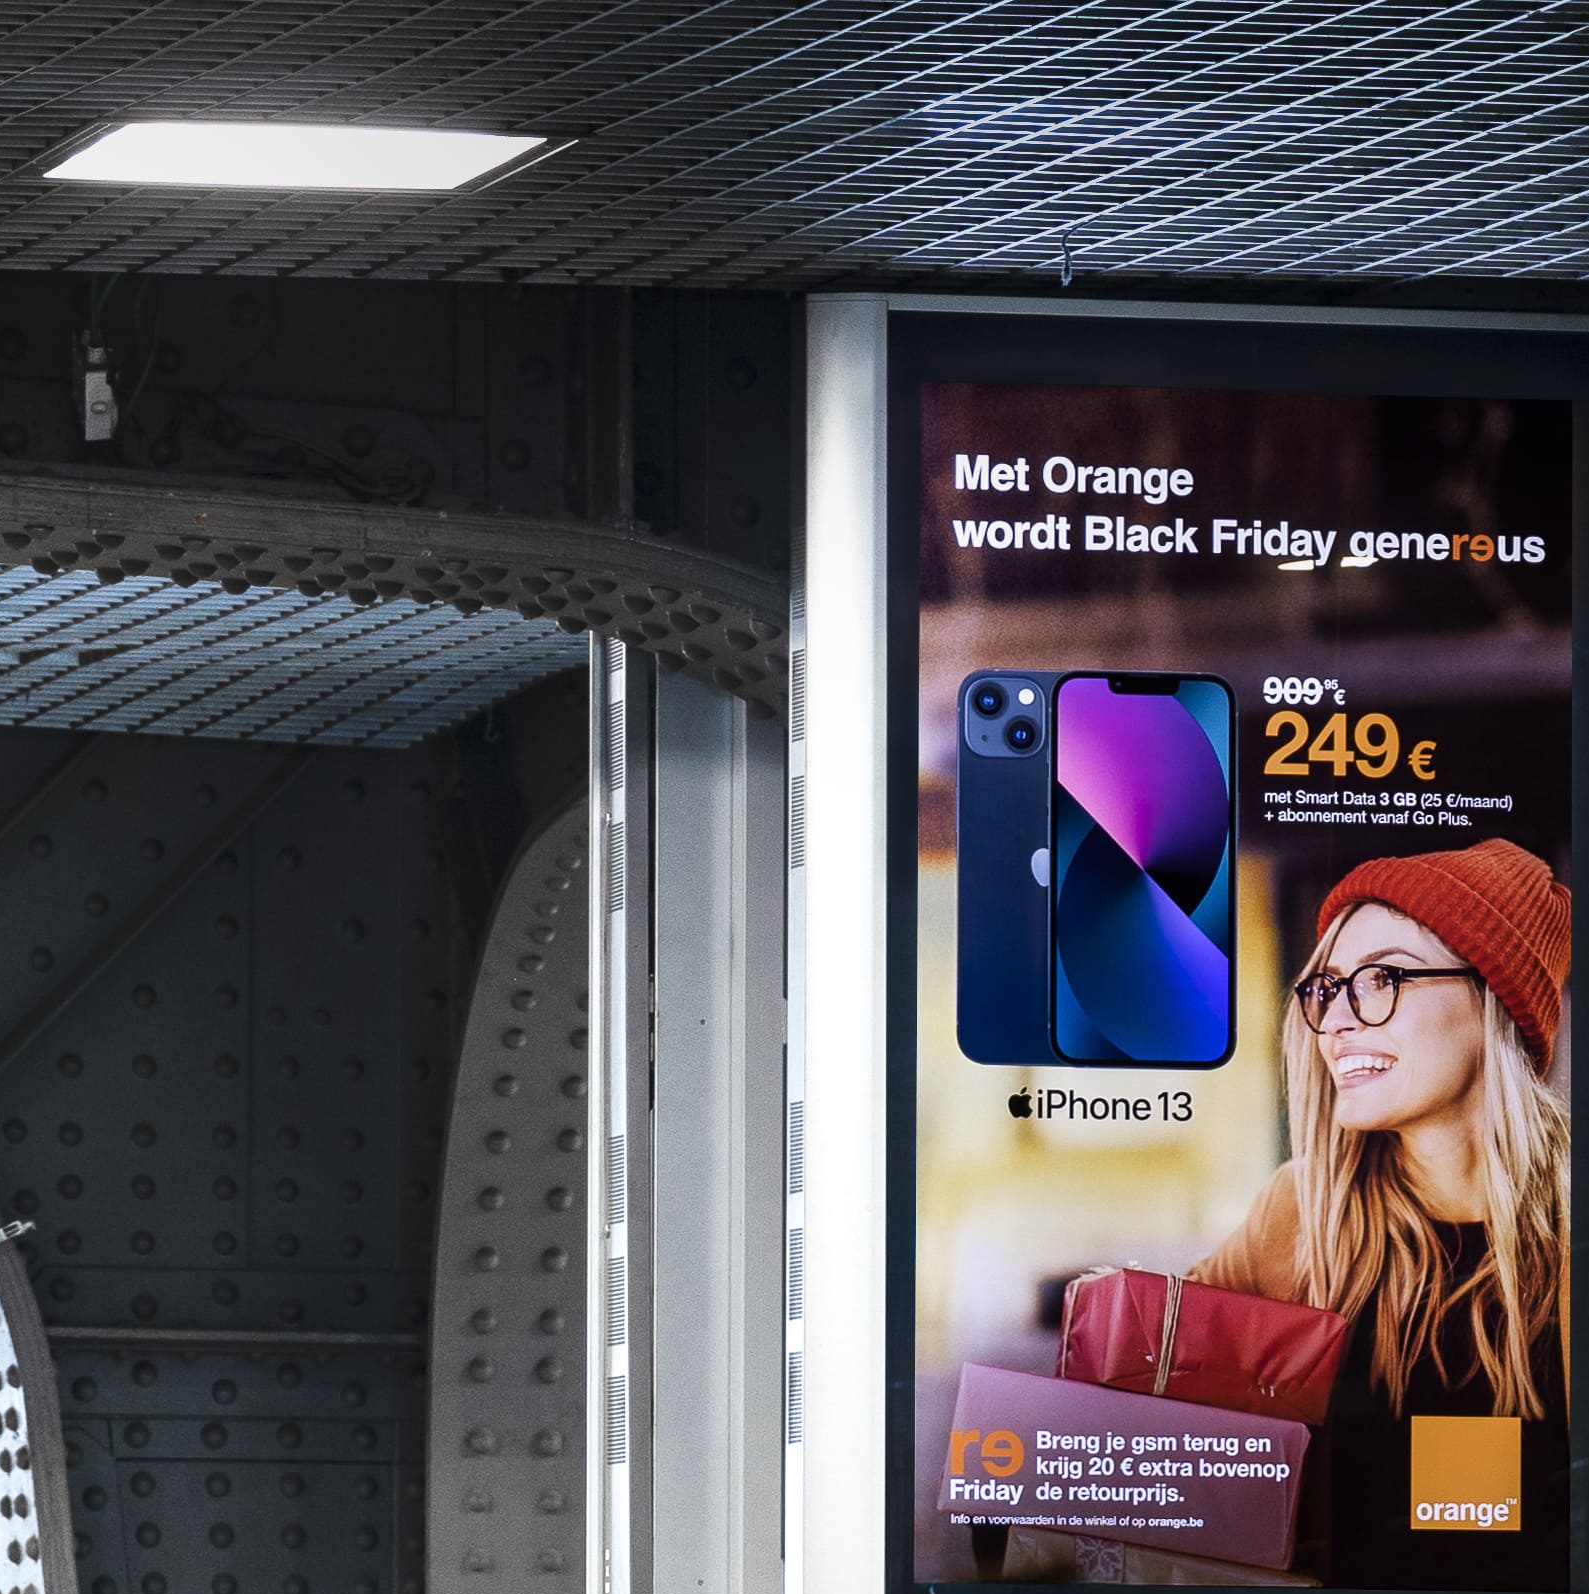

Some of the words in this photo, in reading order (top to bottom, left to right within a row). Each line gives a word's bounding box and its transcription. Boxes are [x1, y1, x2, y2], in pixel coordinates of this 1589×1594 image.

[954, 454, 1029, 491] Met
[1042, 456, 1194, 504] Orange
[952, 514, 1070, 550] wordt
[1084, 515, 1198, 553] Black
[1212, 519, 1337, 566] Friday
[1349, 530, 1546, 567] genereus
[1263, 710, 1400, 779] 249
[1408, 740, 1437, 781] €
[1264, 791, 1291, 804] met
[1296, 790, 1338, 806] Smart
[1343, 792, 1376, 806] Data
[1379, 793, 1390, 806] 3
[1394, 792, 1417, 806] GB
[1421, 793, 1442, 809] (25
[1446, 794, 1513, 812] €/maand)
[1278, 809, 1367, 824] abonnement
[1371, 811, 1410, 825] vanaf
[1413, 811, 1434, 826] Go
[1438, 812, 1472, 826] Plus.
[1037, 1089, 1151, 1122] iPhone
[1158, 1091, 1193, 1122] 13
[1036, 1430, 1100, 1454] Breng
[1105, 1432, 1126, 1454] je
[1131, 1436, 1178, 1454] gsm
[1183, 1434, 1240, 1456] terug
[1245, 1437, 1272, 1452] en
[1036, 1457, 1083, 1479] krijg
[1088, 1457, 1114, 1476] 20
[1120, 1458, 1134, 1476] €
[1139, 1460, 1193, 1477] extra
[1199, 1459, 1290, 1481] bovenop
[949, 1479, 1024, 1505] Friday
[1036, 1482, 1063, 1501] de
[1068, 1483, 1185, 1505] retourprijs.
[950, 1513, 971, 1525] Info
[973, 1516, 986, 1525] en
[988, 1514, 1055, 1526] voorwaarden
[1057, 1515, 1067, 1525] in
[1069, 1515, 1083, 1526] de
[1085, 1515, 1117, 1527] winkel
[1119, 1516, 1130, 1527] of
[1132, 1518, 1146, 1528] op
[1148, 1517, 1204, 1528] orange.be
